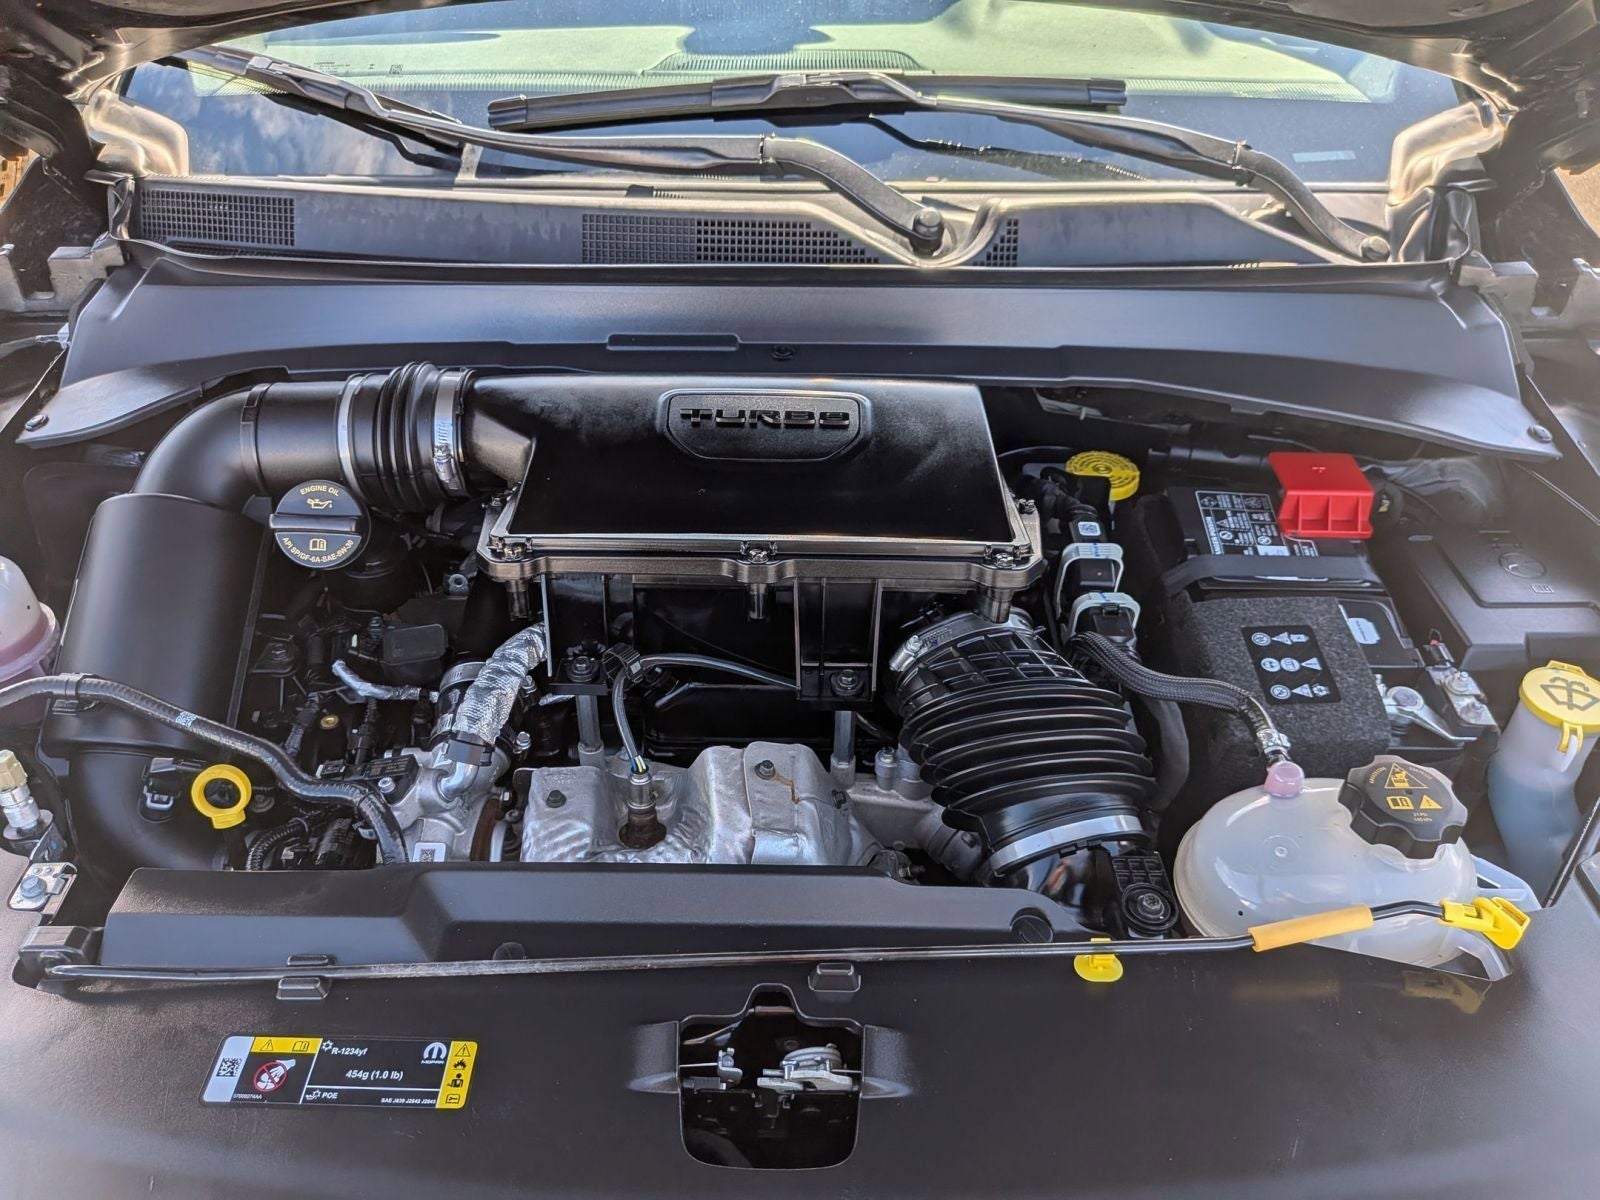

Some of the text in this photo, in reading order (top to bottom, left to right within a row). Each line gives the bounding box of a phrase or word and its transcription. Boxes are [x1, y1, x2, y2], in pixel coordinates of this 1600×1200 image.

[680, 408, 850, 428] TURBO
[300, 485, 339, 496] ENGINE OIL
[282, 537, 293, 549] API
[331, 1047, 368, 1056] R-1234yf
[345, 1070, 404, 1081] 454g (1.0 lb)
